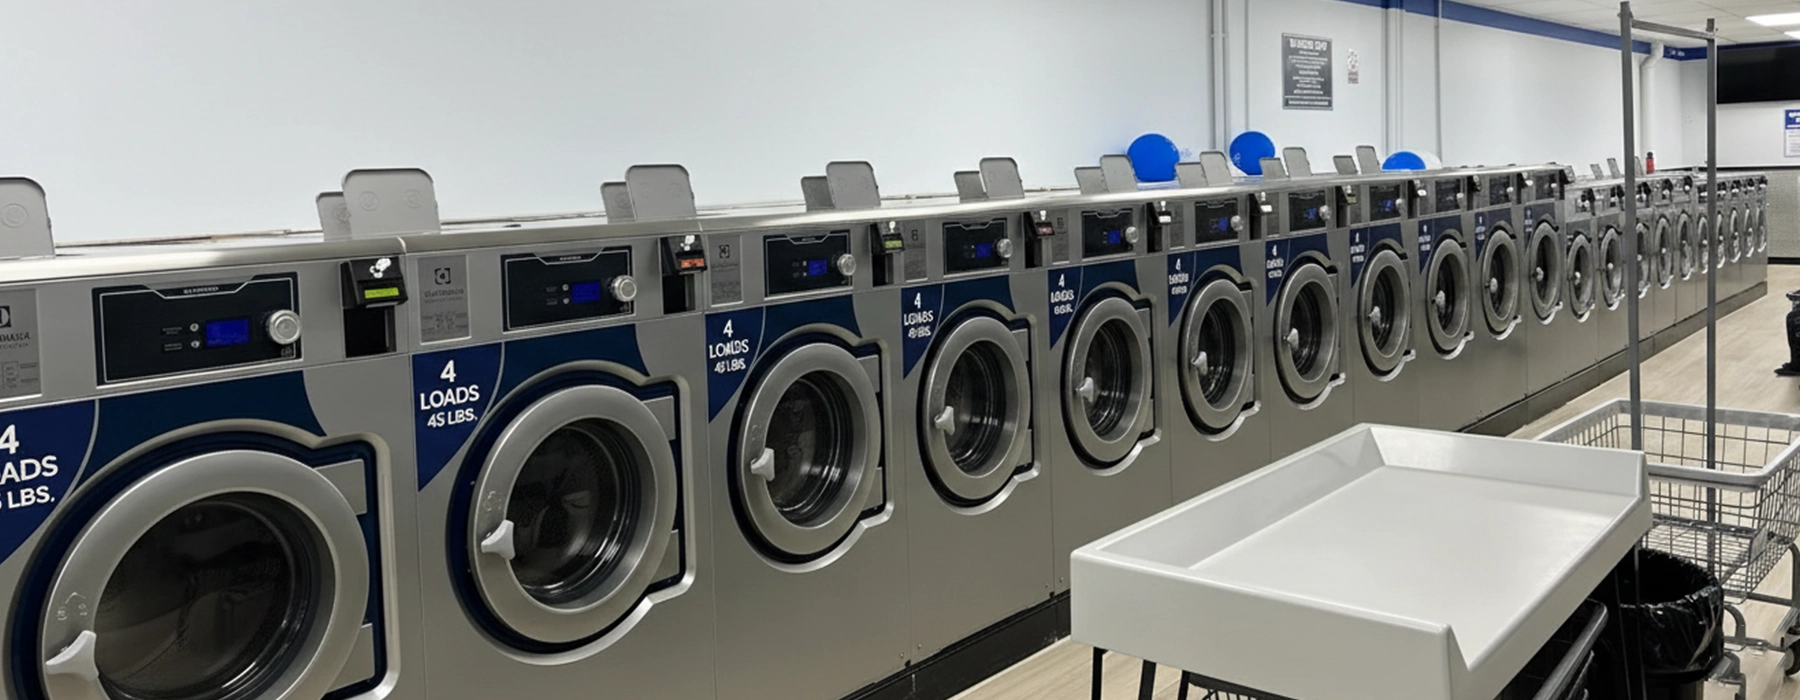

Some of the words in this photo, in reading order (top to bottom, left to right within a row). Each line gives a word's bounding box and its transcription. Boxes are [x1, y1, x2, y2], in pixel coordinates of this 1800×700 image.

[723, 319, 734, 338] 4
[440, 359, 457, 383] 4
[420, 384, 480, 410] LOADS
[0, 424, 20, 454] 4
[0, 455, 59, 485] ADS
